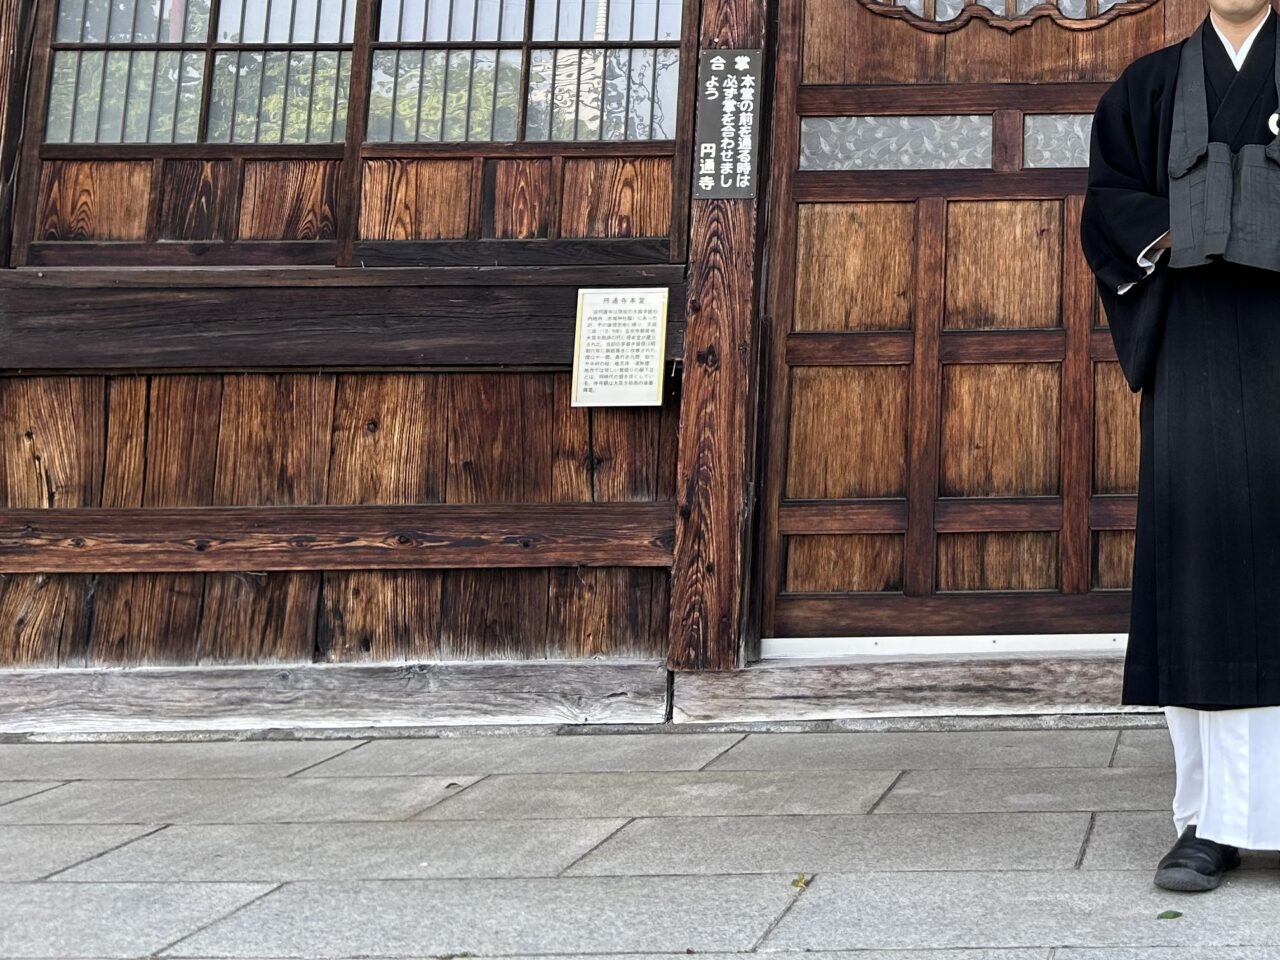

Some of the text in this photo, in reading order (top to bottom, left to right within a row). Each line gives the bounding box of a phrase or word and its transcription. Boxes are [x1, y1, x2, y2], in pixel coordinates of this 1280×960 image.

[698, 143, 716, 190] 円通寺
[720, 74, 739, 188] 必ず掌を合わせまし
[736, 74, 755, 188] 本堂の前を通る時は
